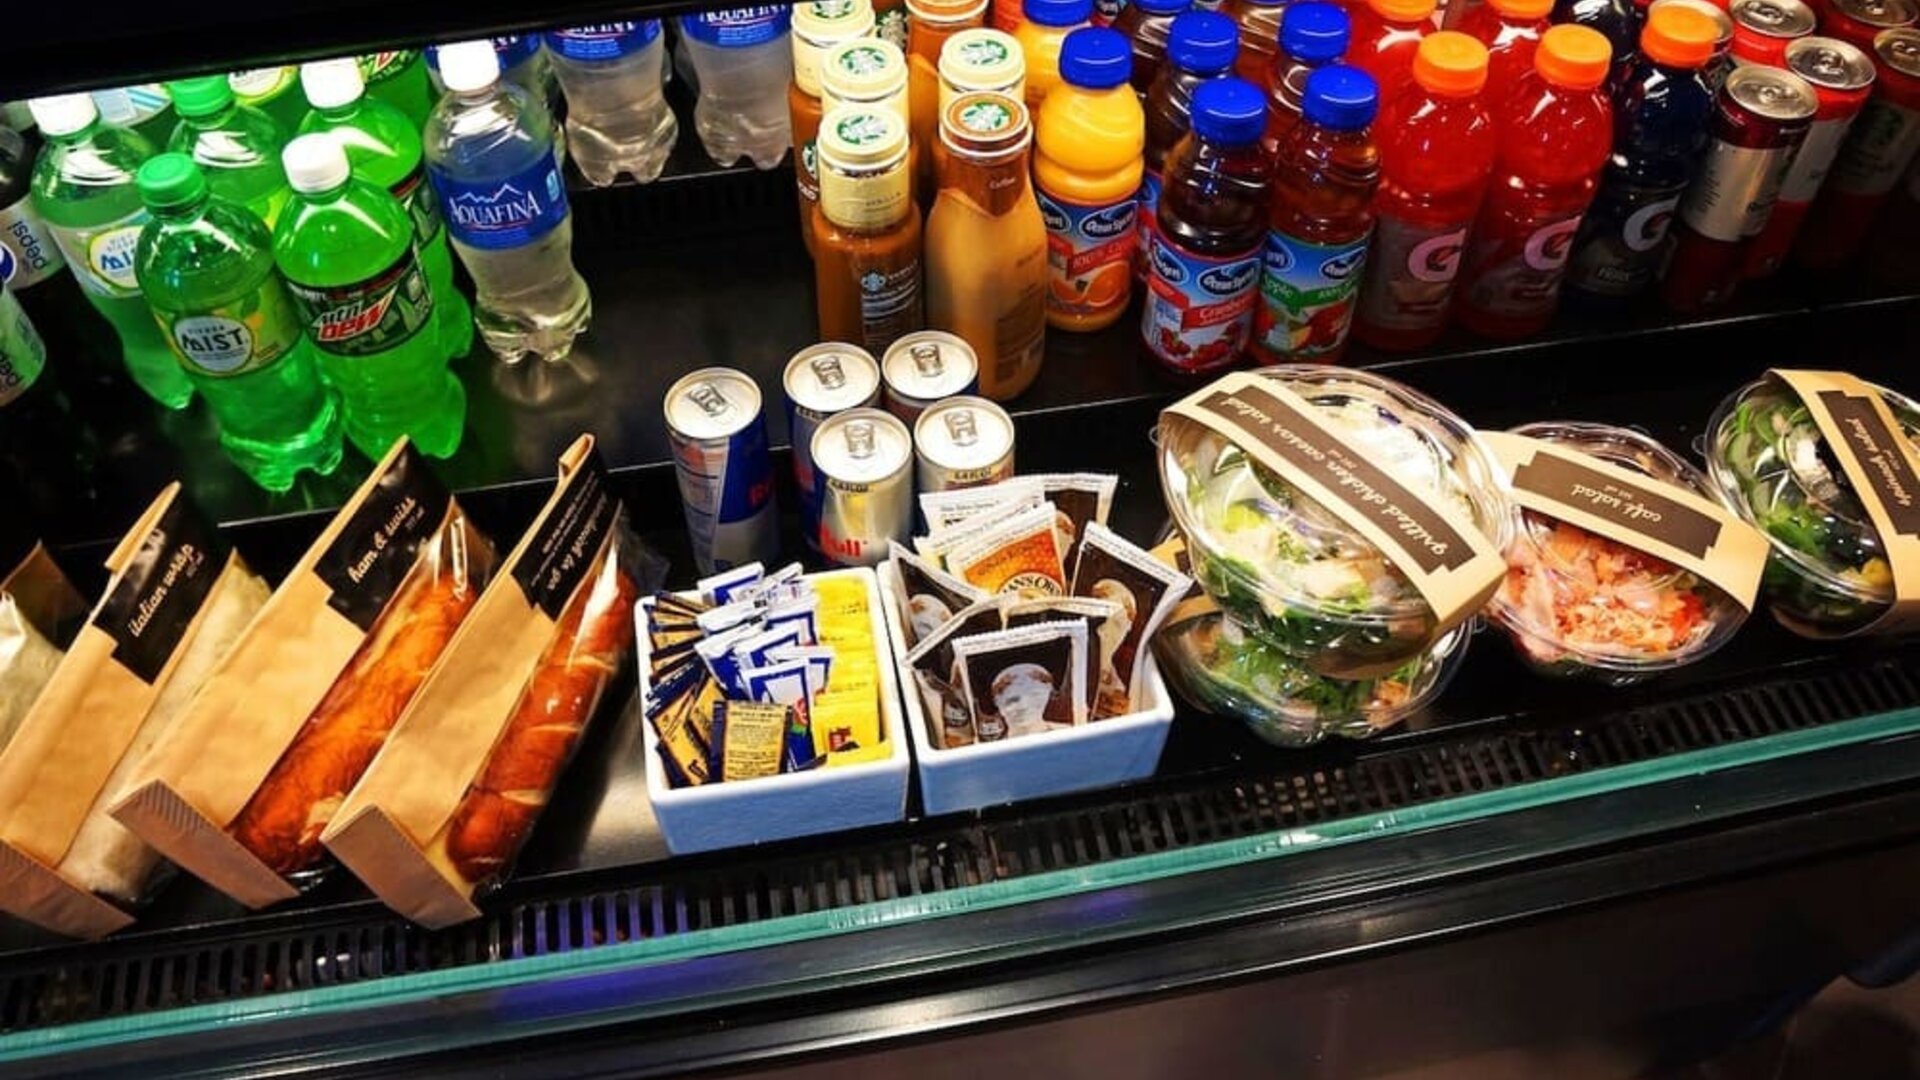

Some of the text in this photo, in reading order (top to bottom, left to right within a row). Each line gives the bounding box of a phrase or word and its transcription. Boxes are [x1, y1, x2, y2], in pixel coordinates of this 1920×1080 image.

[449, 190, 542, 224] AQUAFINA
[8, 220, 48, 271] pepsi
[100, 249, 136, 270] MI
[180, 327, 244, 352] MIST
[1220, 395, 1272, 425] salad
[1271, 423, 1326, 462] caesar
[1325, 460, 1387, 507] chicken
[1571, 483, 1621, 508] salad
[346, 549, 379, 583] ham
[373, 530, 388, 550] &
[384, 496, 416, 537] swiss
[1381, 502, 1449, 556] grilled
[127, 585, 168, 637] italian
[162, 543, 196, 587] wrap
